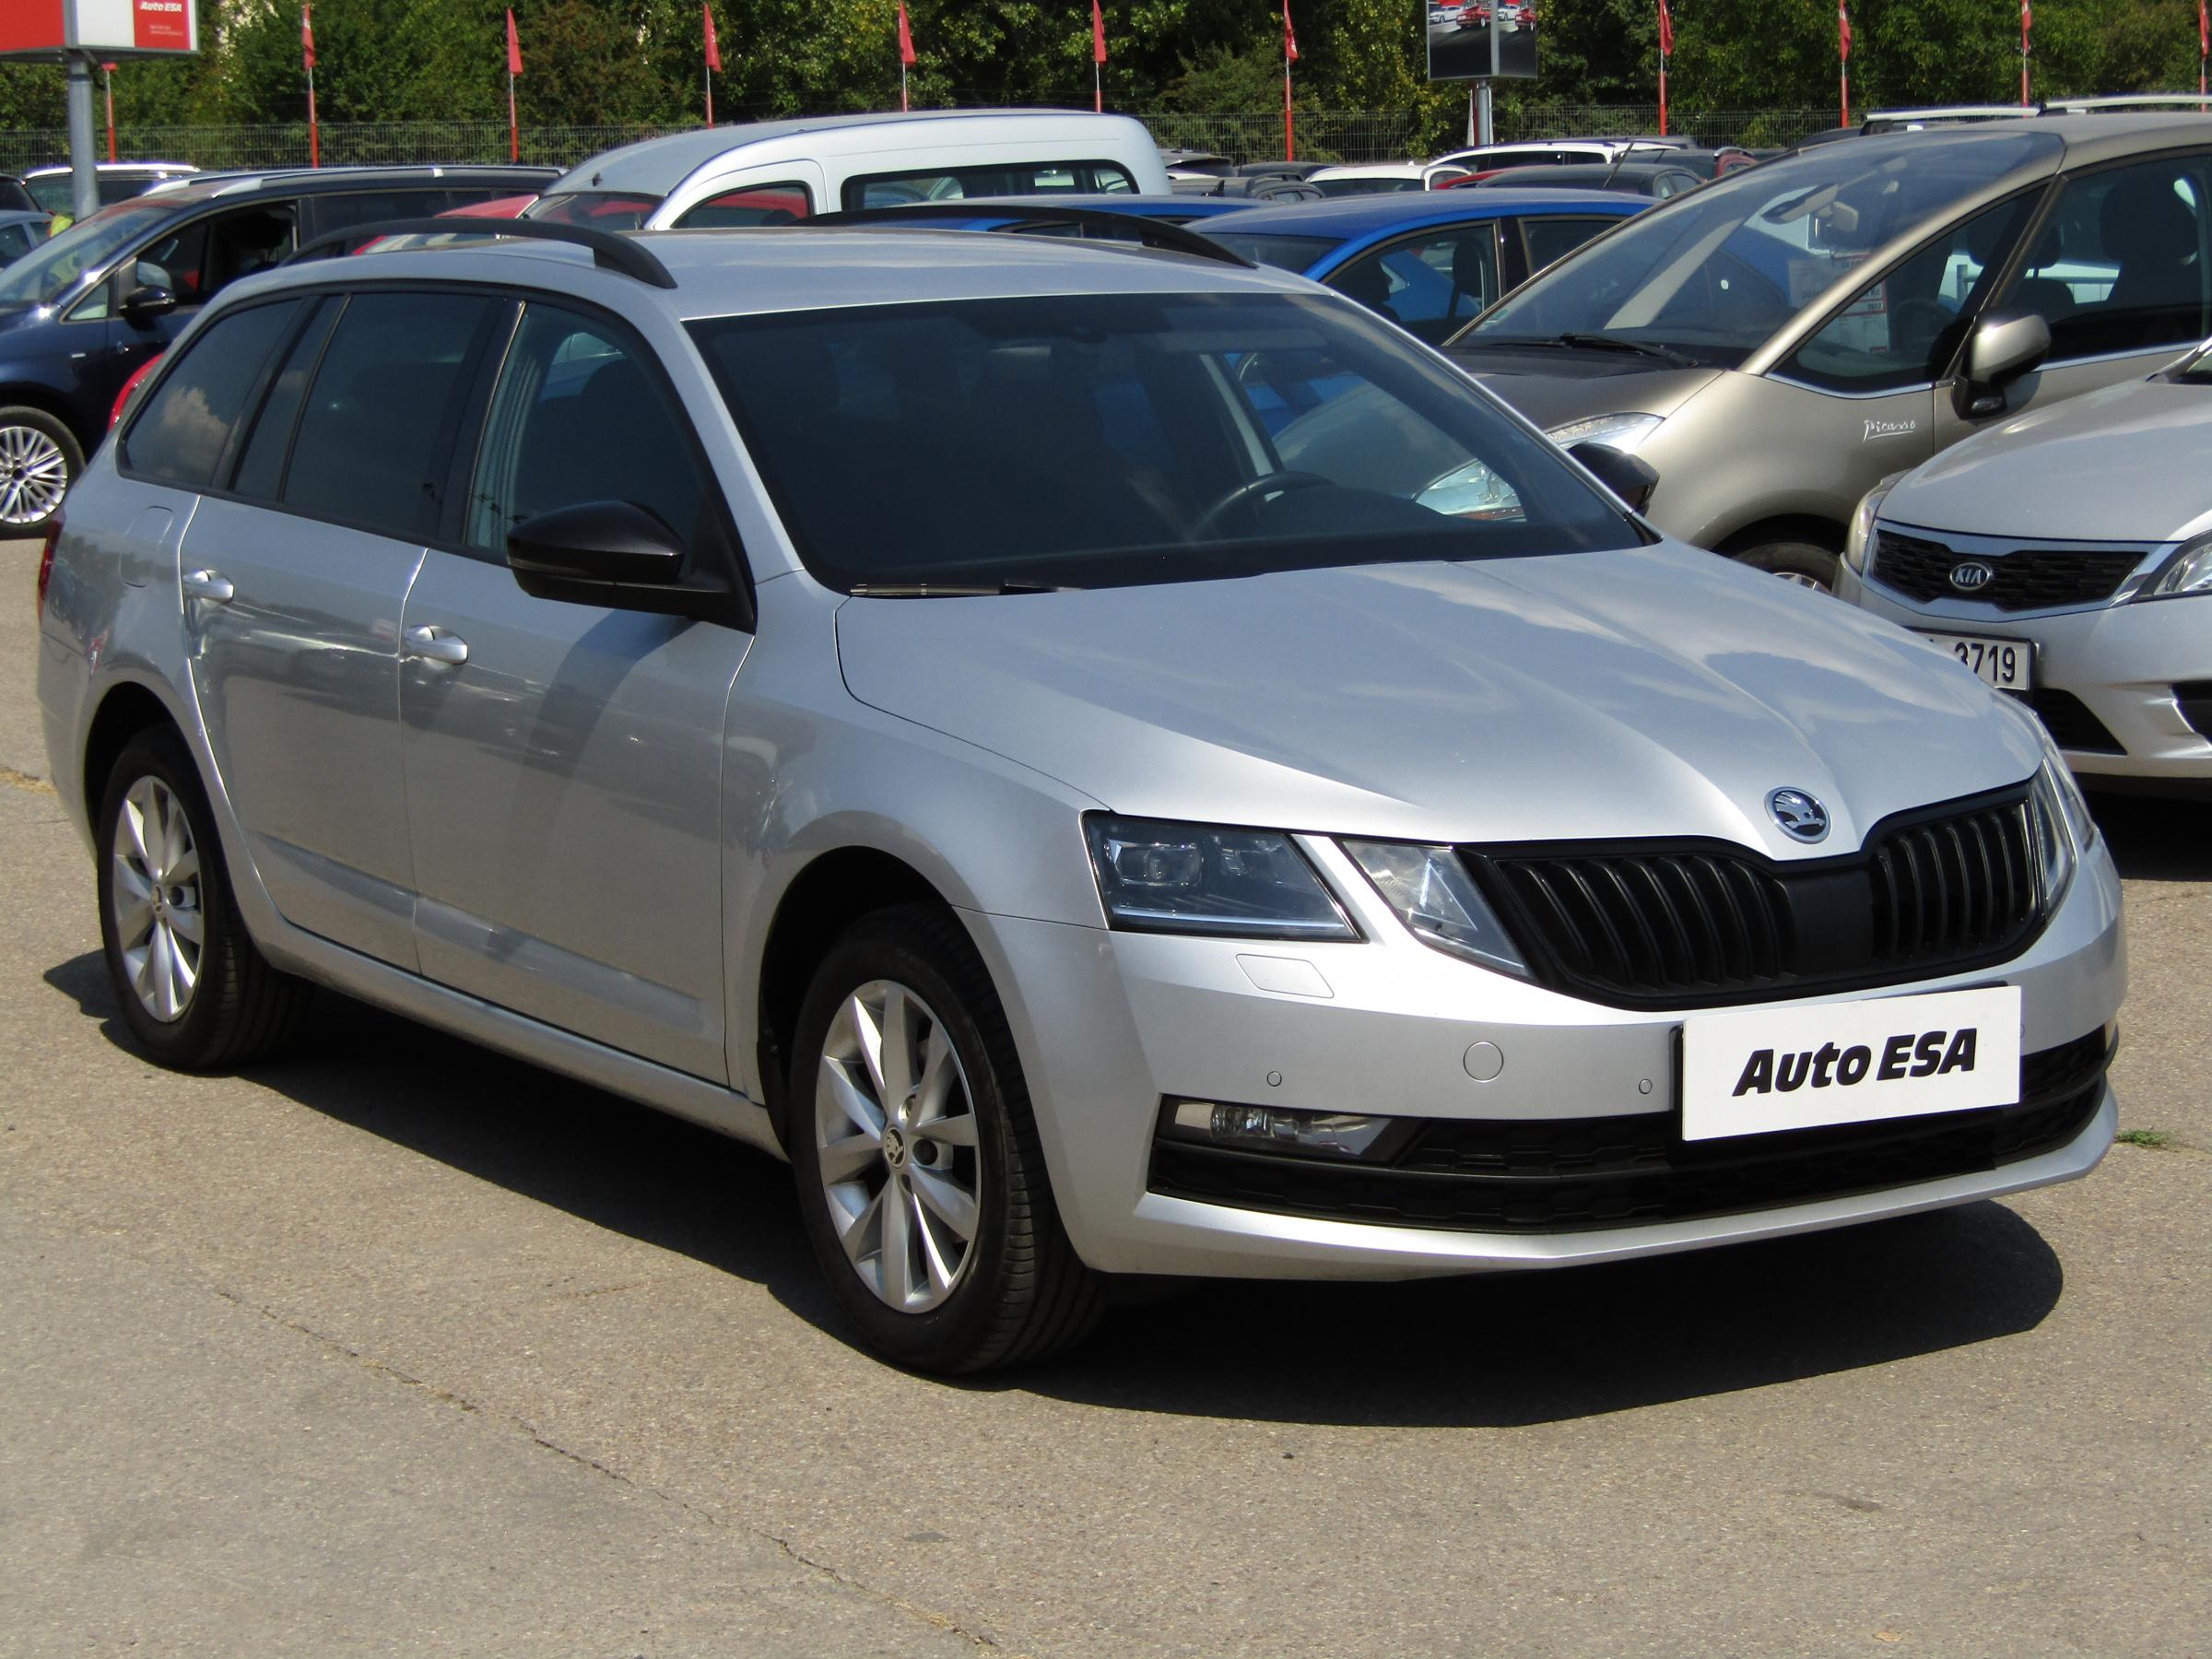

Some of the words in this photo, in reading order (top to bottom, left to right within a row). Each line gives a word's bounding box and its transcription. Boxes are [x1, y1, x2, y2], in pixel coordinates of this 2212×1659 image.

[140, 1, 164, 11] Auto
[164, 3, 182, 12] ESA
[1863, 419, 1916, 442] Picasso
[1955, 568, 1982, 584] KIA
[1732, 1041, 1872, 1097] Auto
[1876, 1028, 1978, 1081] ESA
